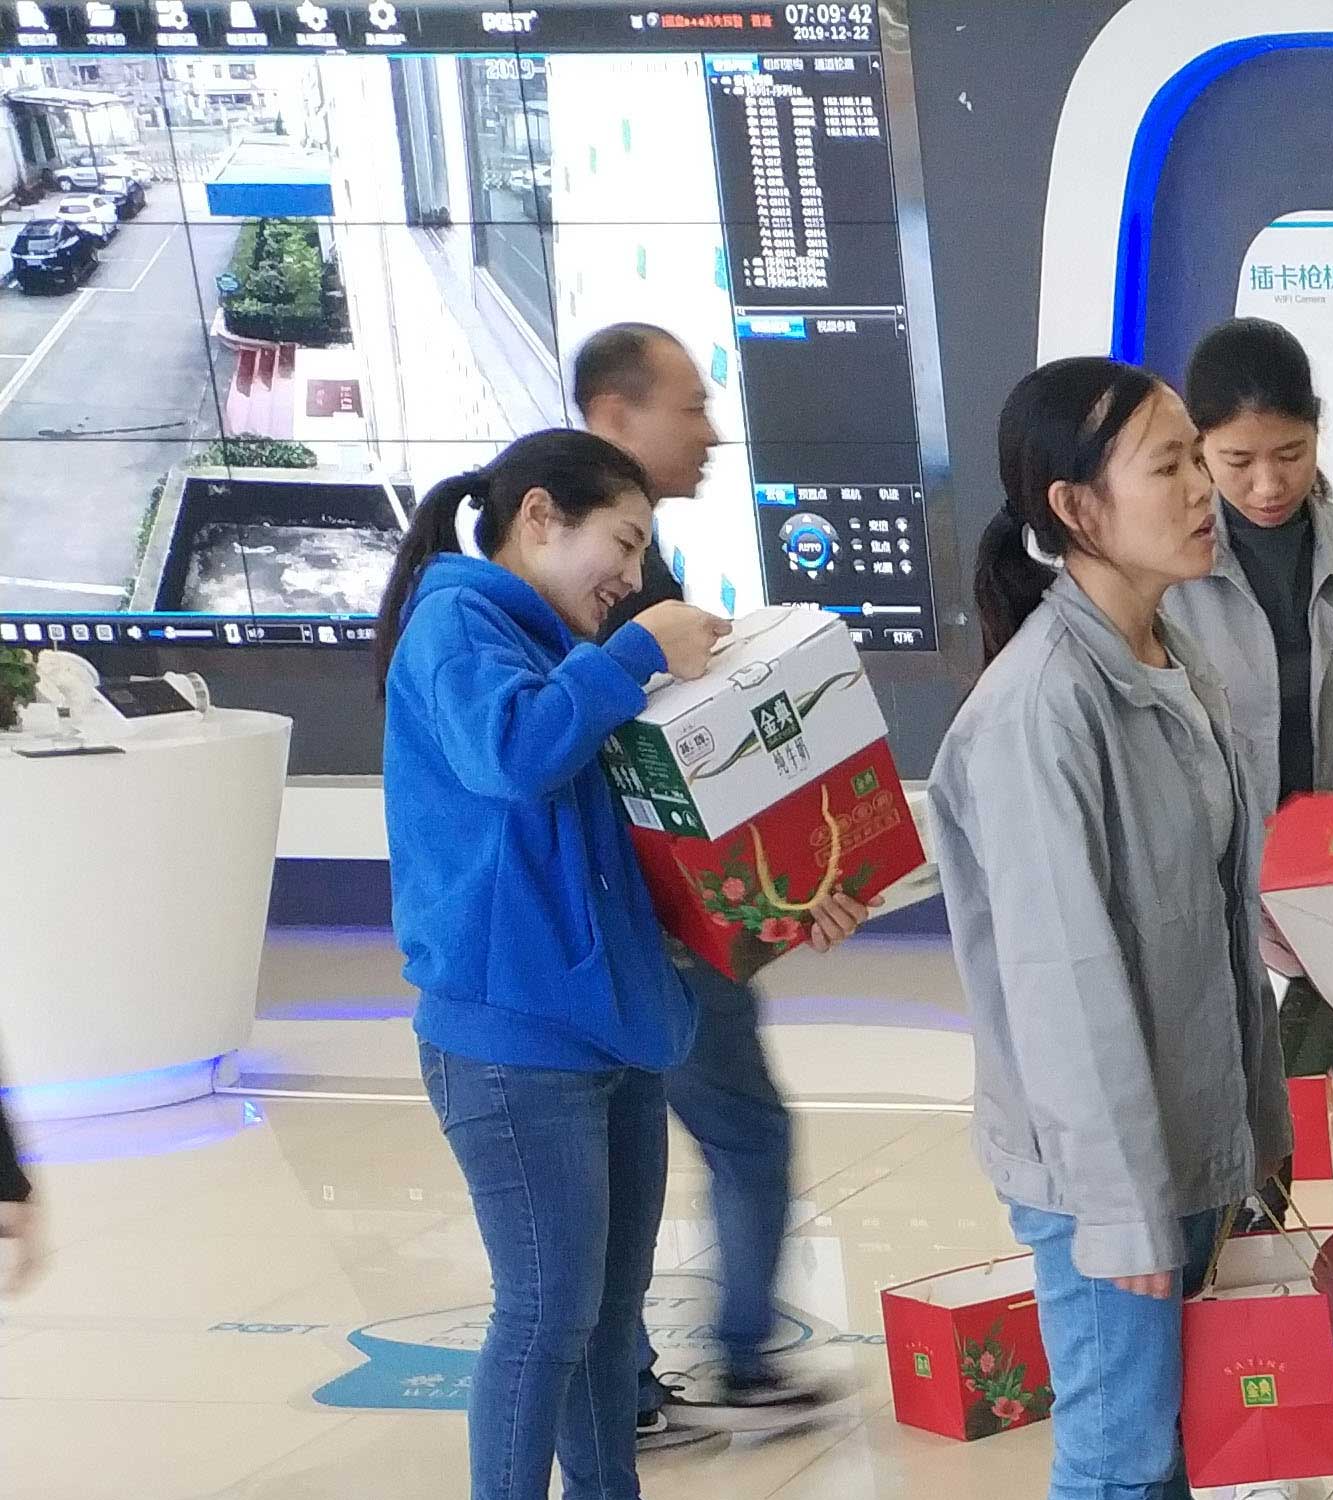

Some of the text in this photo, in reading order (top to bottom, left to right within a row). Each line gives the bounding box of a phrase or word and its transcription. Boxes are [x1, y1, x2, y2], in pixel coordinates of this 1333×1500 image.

[785, 5, 873, 24] 07:09:42
[793, 26, 870, 40] 2019-12-22
[760, 699, 794, 739] 金典
